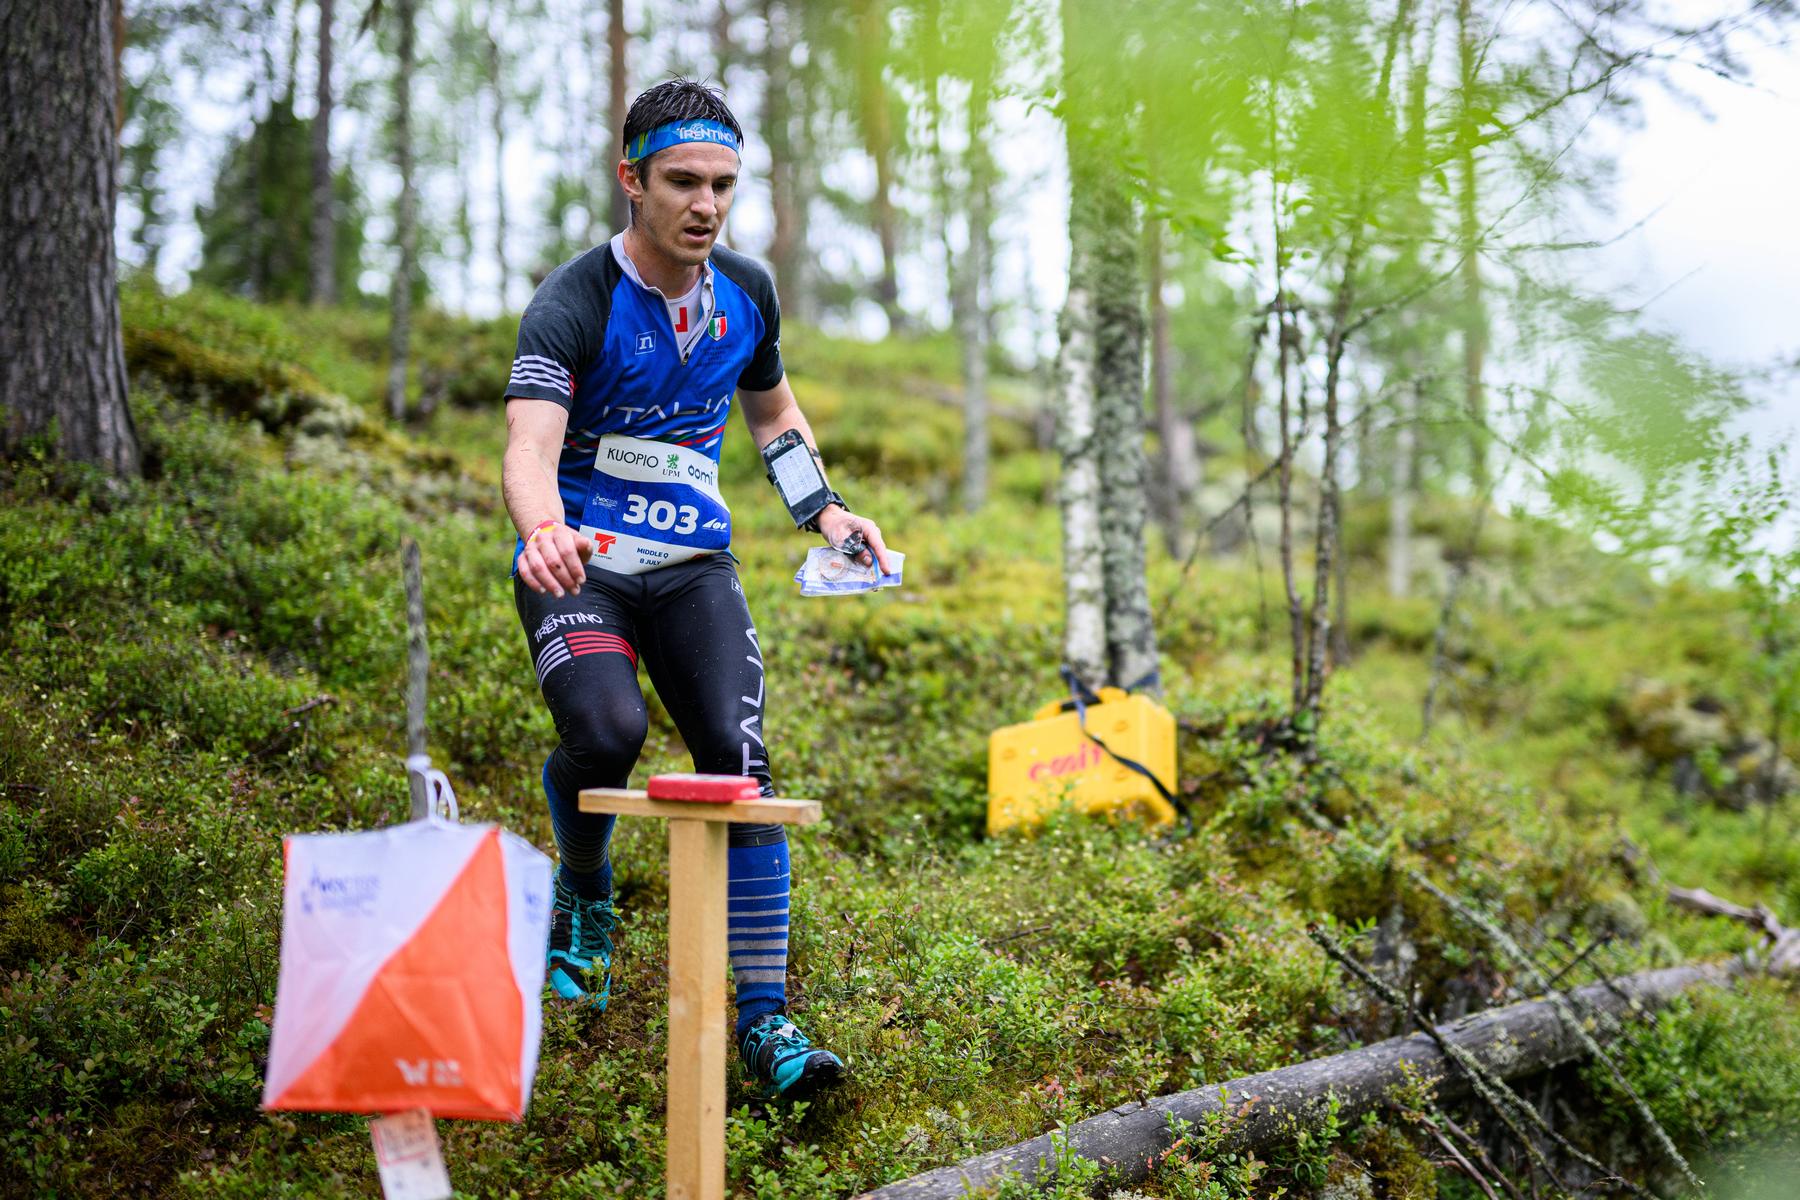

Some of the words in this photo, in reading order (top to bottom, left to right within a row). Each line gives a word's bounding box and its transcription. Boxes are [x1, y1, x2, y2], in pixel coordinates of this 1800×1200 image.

[677, 127, 733, 142] TRENTINO
[602, 394, 730, 424] ITALIA
[607, 448, 659, 468] KUOPIO
[662, 468, 680, 478] UPM
[688, 464, 713, 486] oomi
[622, 494, 699, 535] 303
[637, 547, 662, 558] MIDDLE
[535, 612, 603, 643] TRENTINO
[741, 628, 764, 776] TALIA
